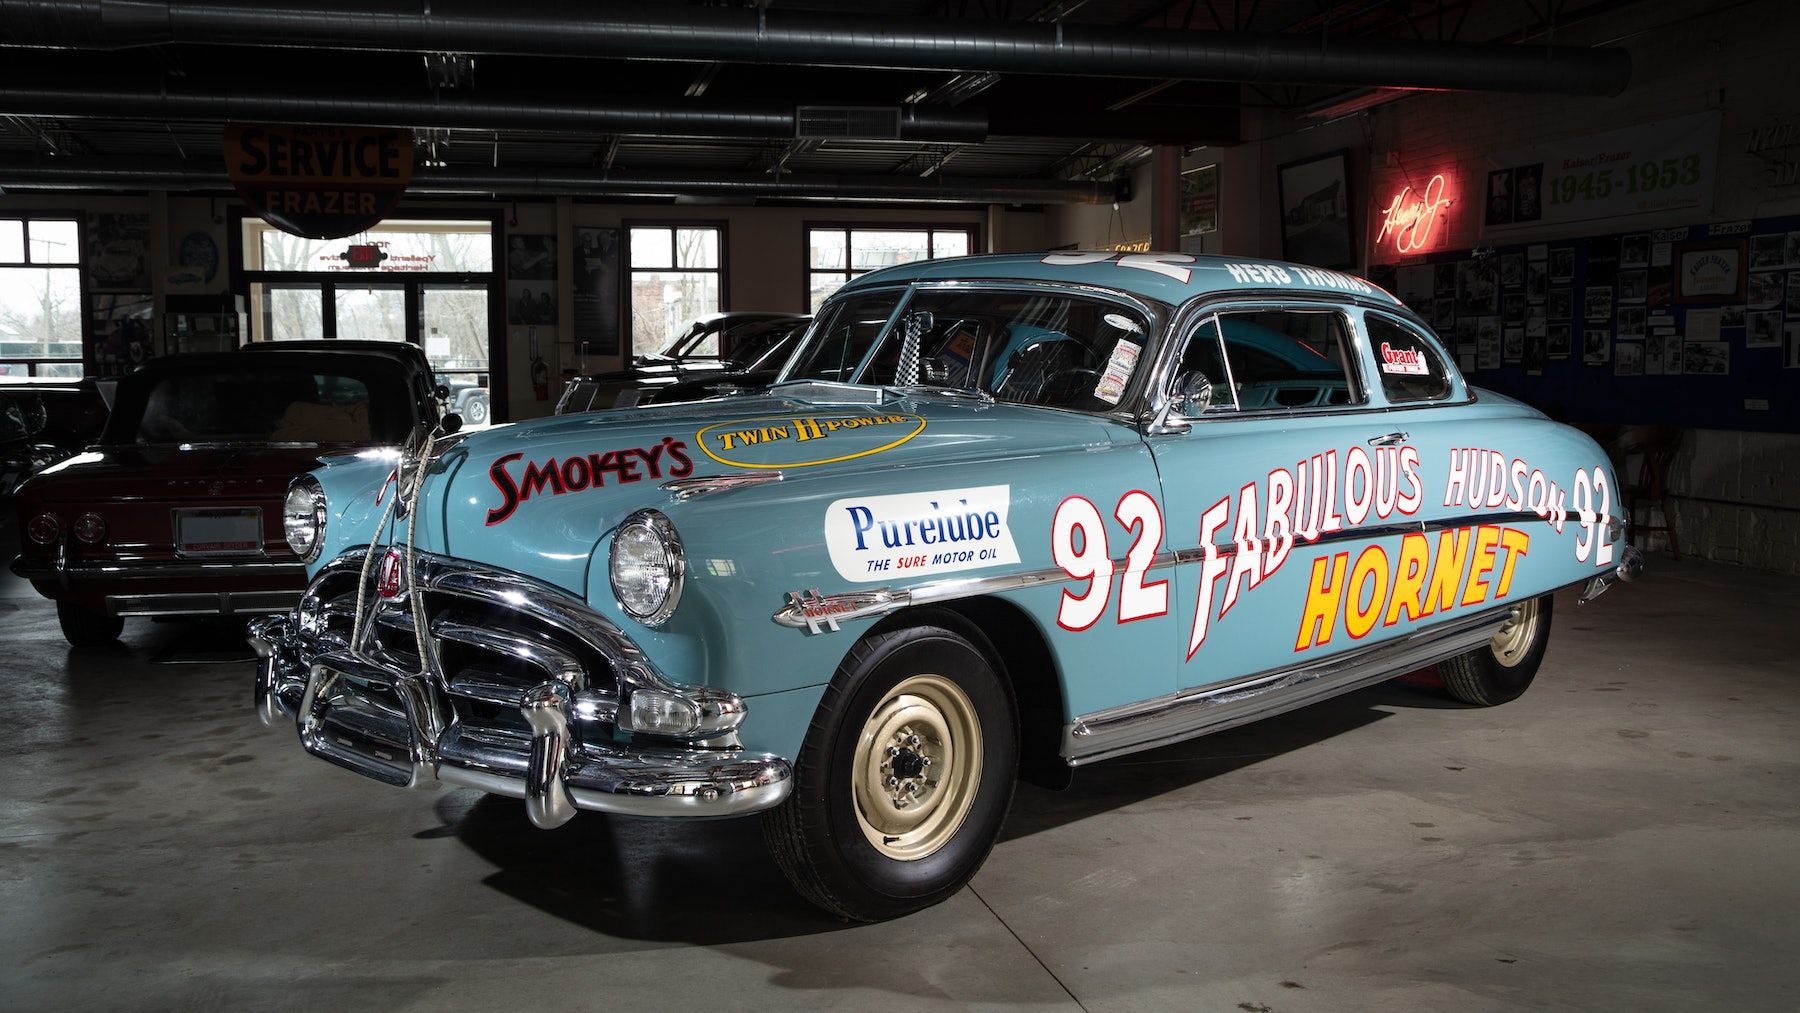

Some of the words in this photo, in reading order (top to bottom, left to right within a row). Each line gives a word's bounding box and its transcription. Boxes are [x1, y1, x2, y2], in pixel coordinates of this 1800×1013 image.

[240, 127, 400, 178] SERVICE
[266, 190, 376, 215] FRAZER
[1550, 153, 1701, 205] 1945-1953
[1224, 263, 1291, 285] HERB
[1381, 342, 1419, 364] Grant
[717, 428, 790, 452] TWIN
[485, 436, 693, 527] SMOKEY'S
[845, 498, 1000, 551] Purelube
[1573, 465, 1613, 567] 92
[867, 558, 890, 572] THE
[896, 555, 927, 569] SURE
[932, 550, 974, 565] MOTOR
[979, 548, 997, 560] OIL
[1052, 489, 1169, 632] 92
[1186, 446, 1424, 663] FABULOUS
[1443, 447, 1567, 535] HUDSON
[1294, 523, 1529, 653] HORNET
